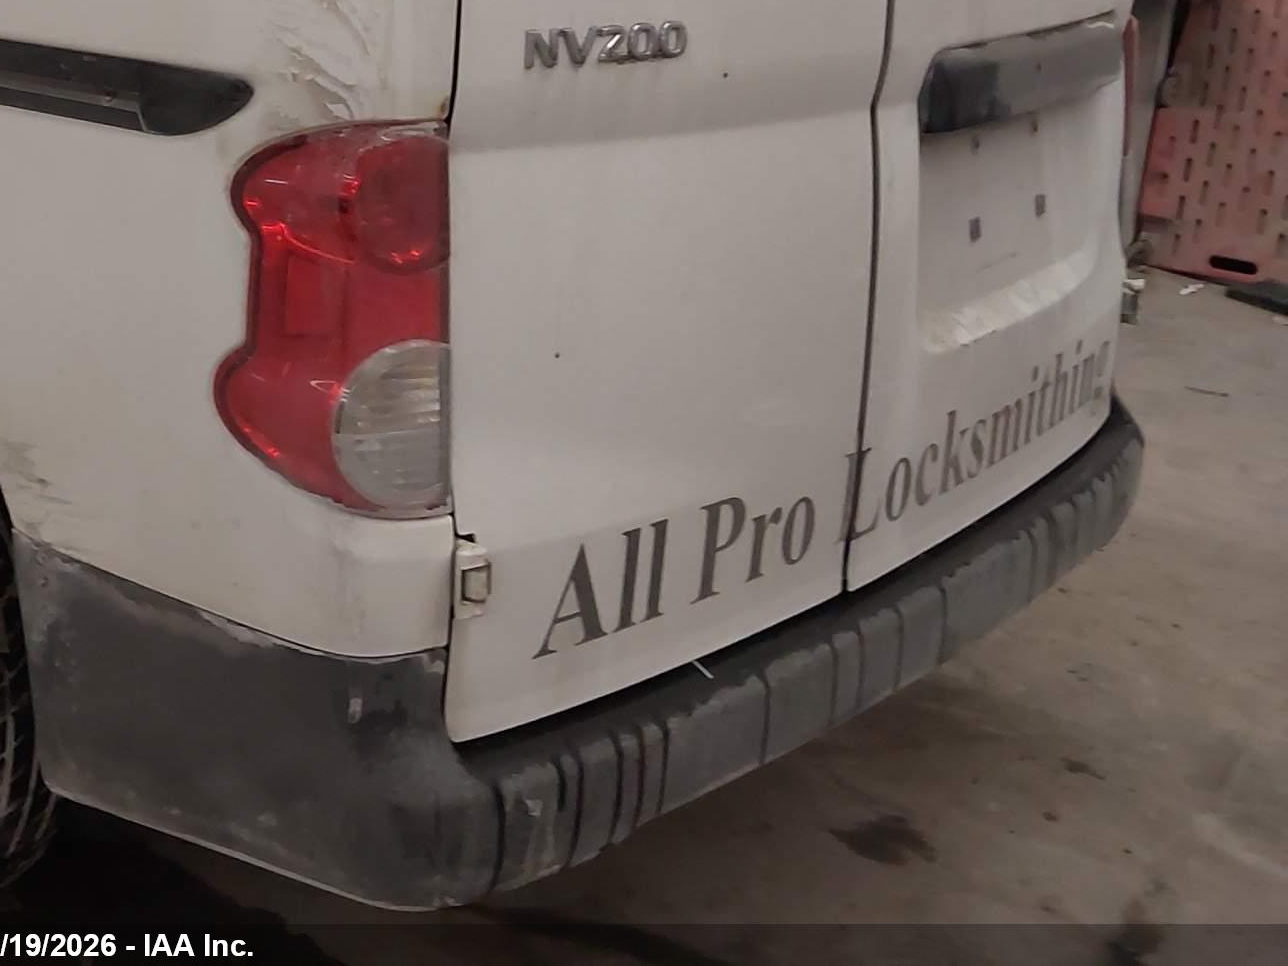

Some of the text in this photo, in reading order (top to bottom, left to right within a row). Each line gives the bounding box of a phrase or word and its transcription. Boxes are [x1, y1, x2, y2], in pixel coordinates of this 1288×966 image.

[523, 20, 688, 69] NV200
[532, 340, 1110, 659] All Pro Locksmithing
